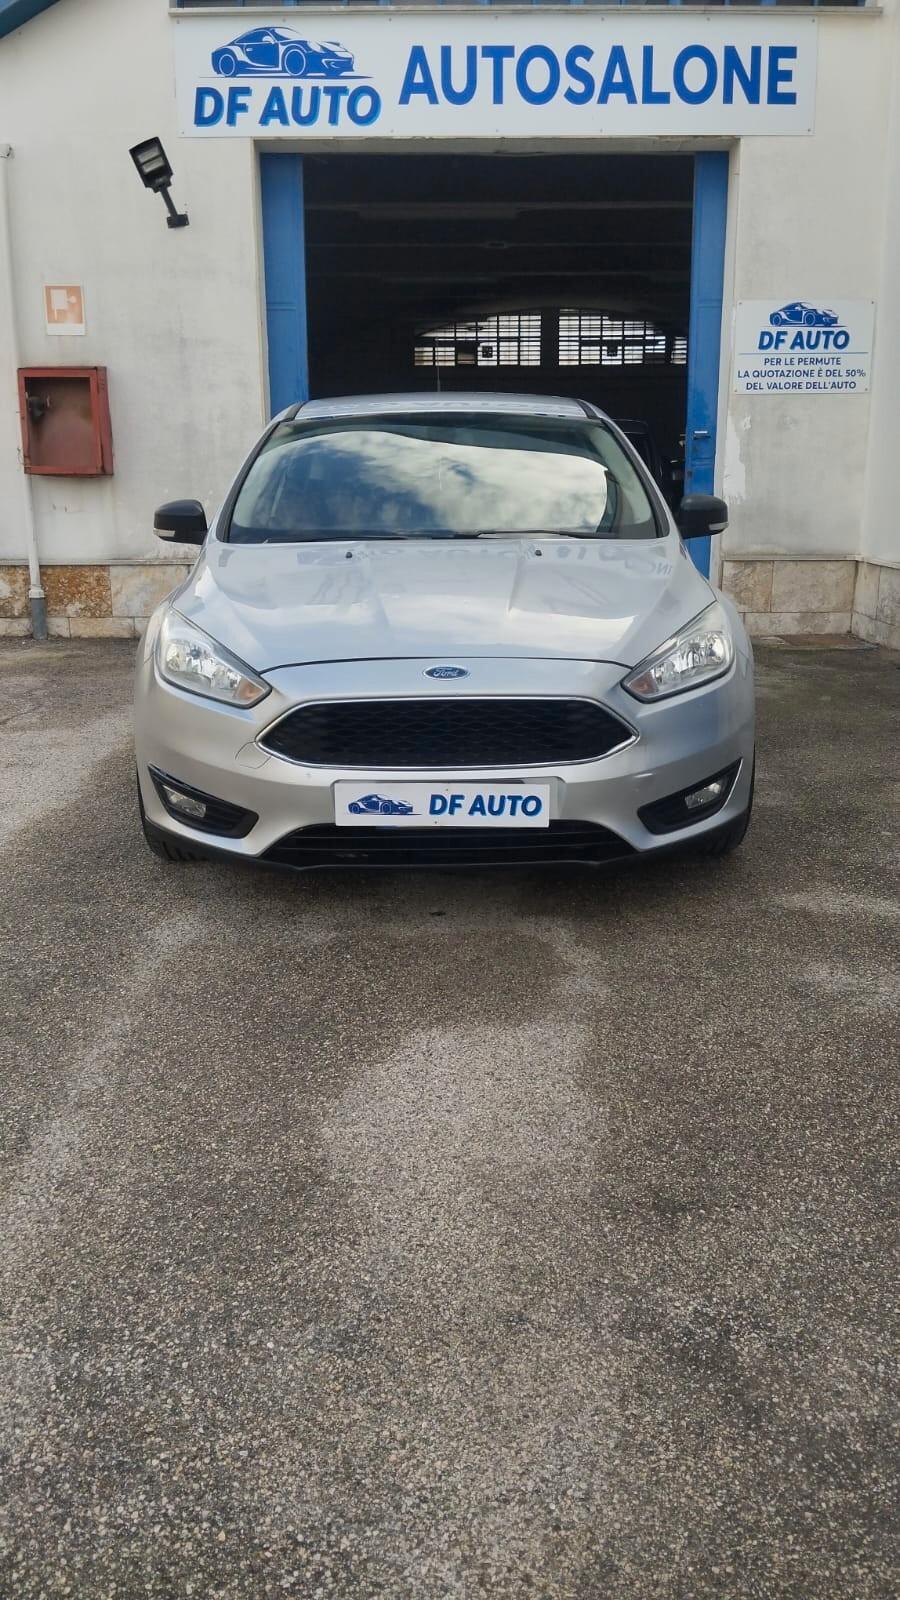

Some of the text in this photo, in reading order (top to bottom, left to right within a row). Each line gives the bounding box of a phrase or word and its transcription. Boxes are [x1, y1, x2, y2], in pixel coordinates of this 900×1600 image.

[398, 44, 798, 105] AUTOSALONE
[194, 85, 382, 127] DF AUTO
[758, 330, 850, 350] DF AUTO
[764, 357, 841, 366] PER LE PERMUTE
[737, 367, 866, 378] LA QUOTAZIONE È DEL 50%
[746, 381, 857, 391] DEL VALORE DELL'AUTO
[433, 667, 459, 677] Ford
[429, 794, 543, 817] DF AUTO
